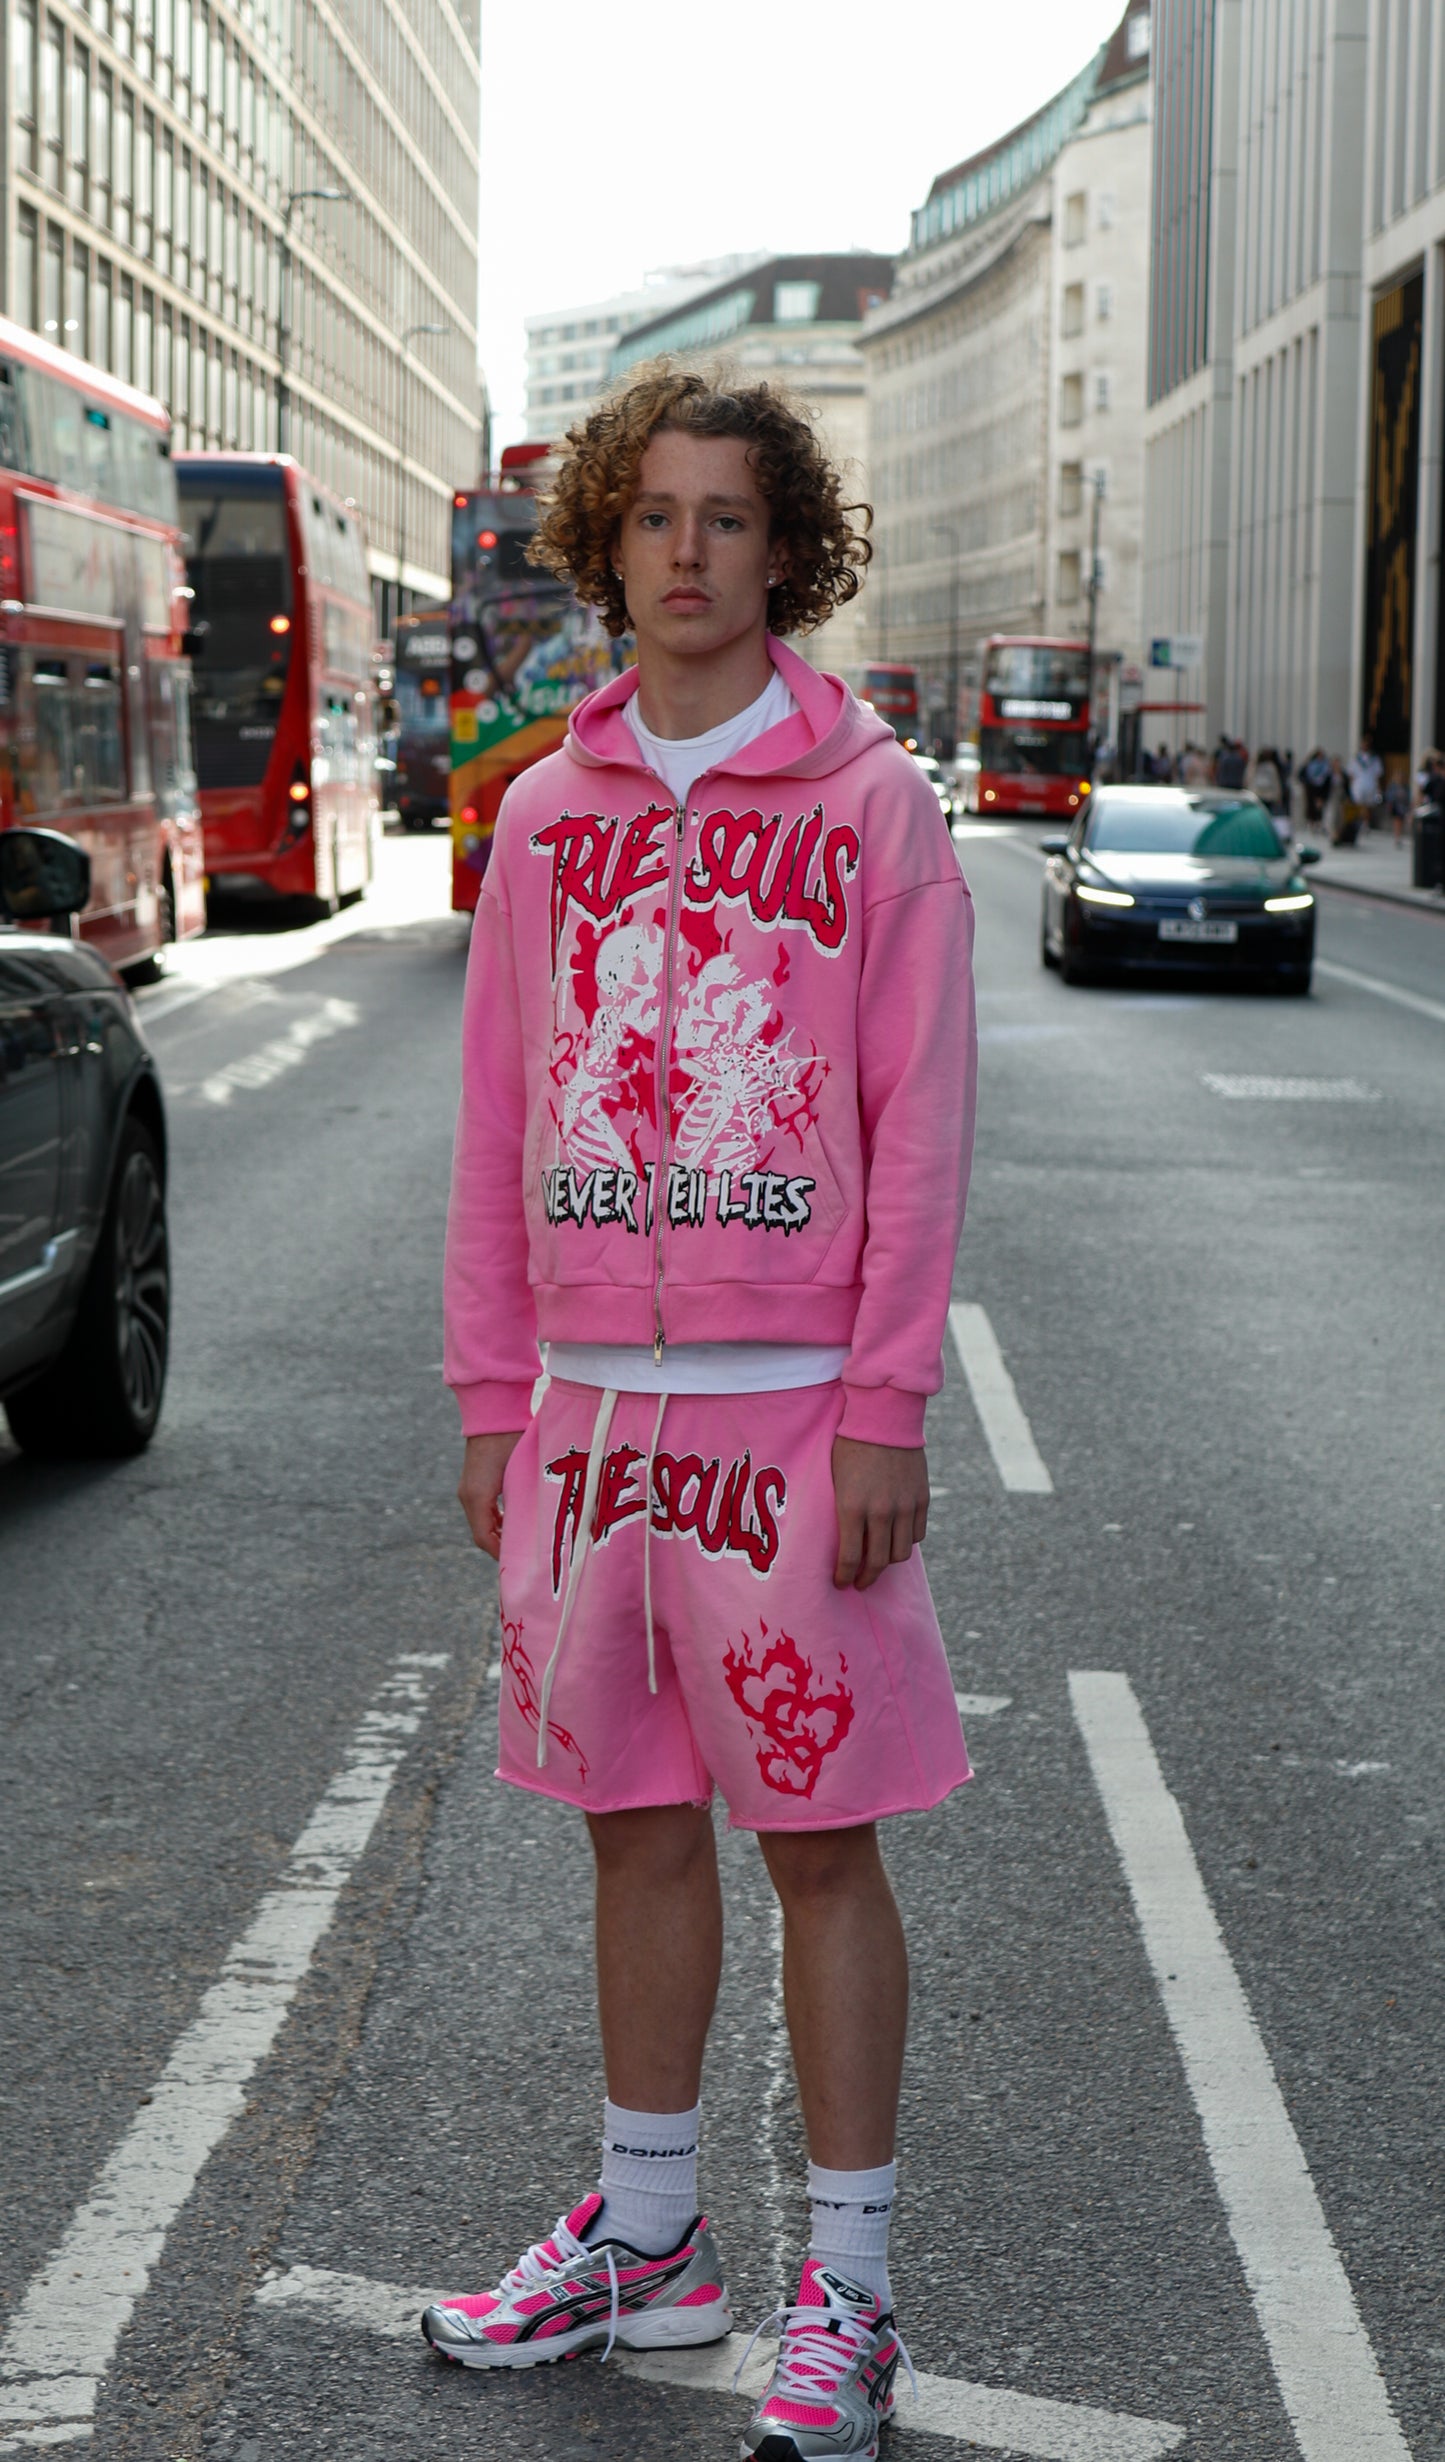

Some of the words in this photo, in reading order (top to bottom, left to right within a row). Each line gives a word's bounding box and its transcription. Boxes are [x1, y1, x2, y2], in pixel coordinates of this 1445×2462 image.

[529, 803, 673, 988] TRUE
[682, 802, 861, 958] SOULS
[541, 1166, 638, 1234] NEVER
[716, 1169, 816, 1237] LIES
[650, 1448, 787, 1581] SOULS
